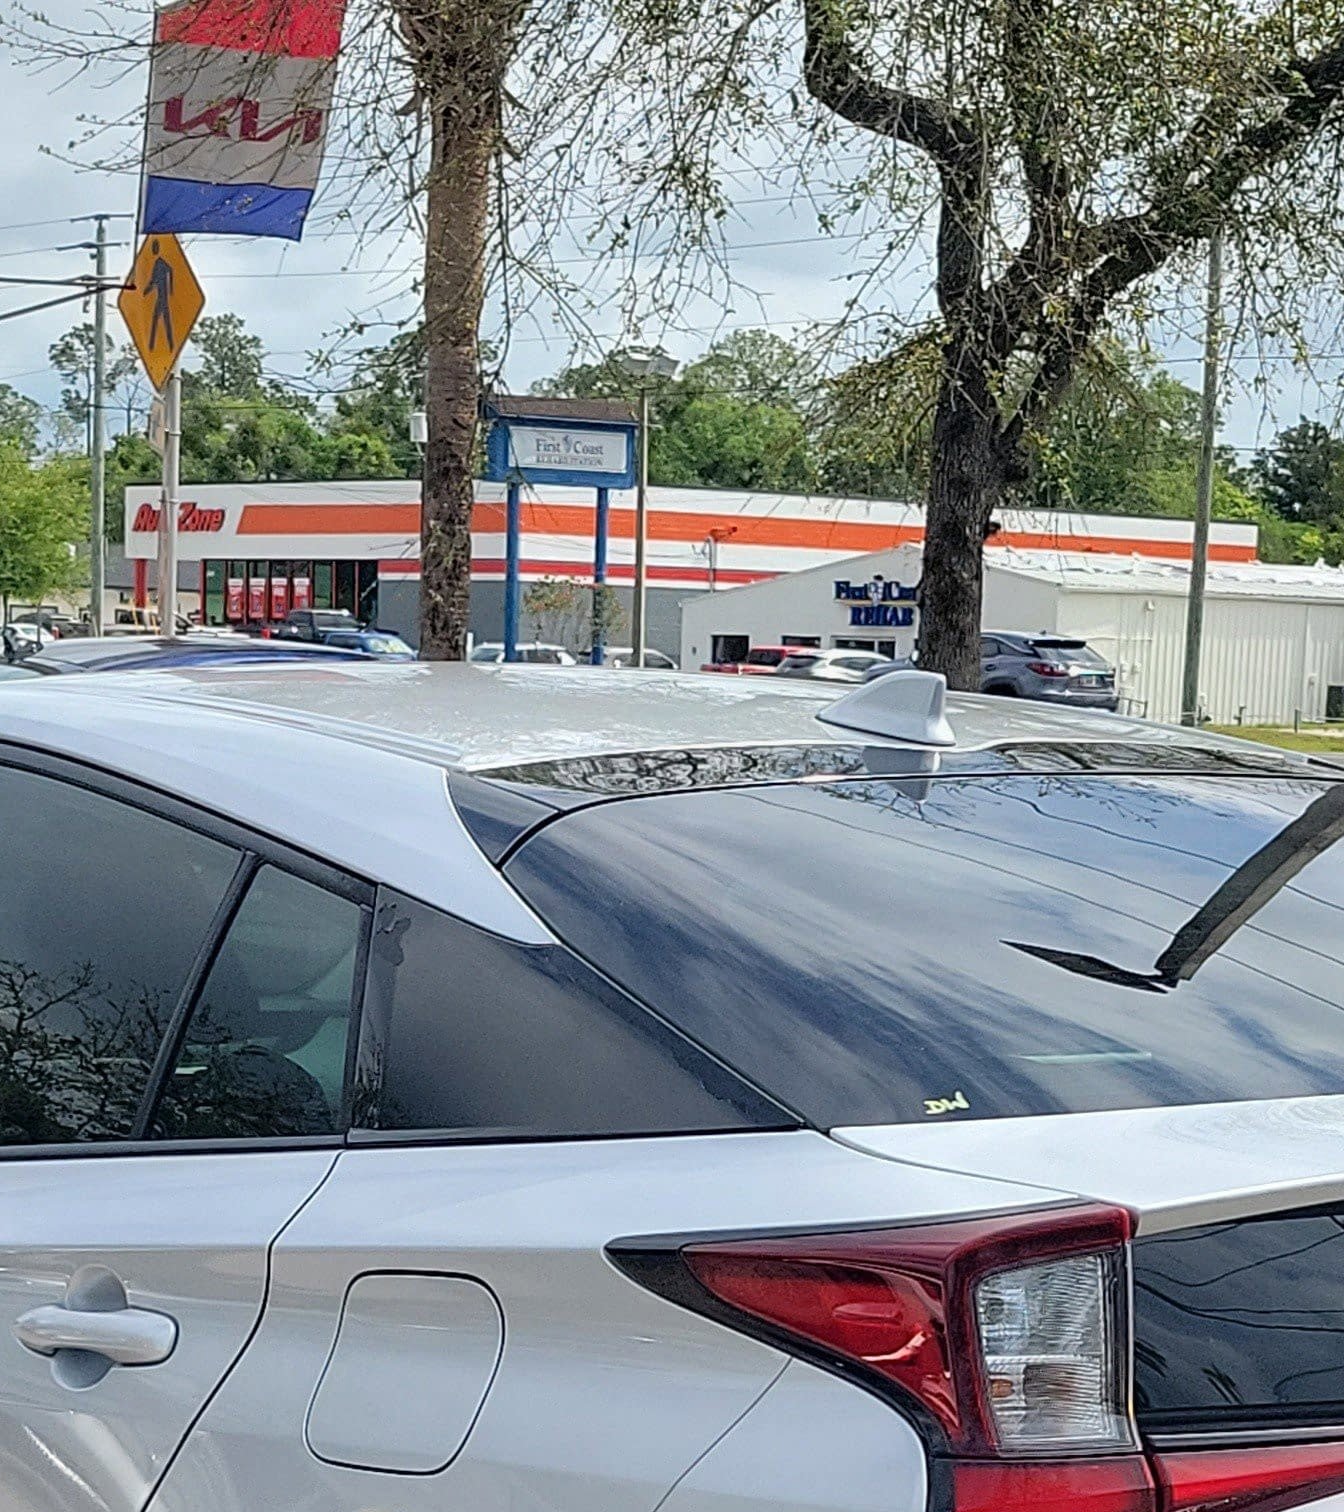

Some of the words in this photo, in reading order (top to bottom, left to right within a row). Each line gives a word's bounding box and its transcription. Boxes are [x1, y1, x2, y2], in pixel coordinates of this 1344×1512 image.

[536, 437, 561, 454] First
[573, 441, 604, 456] Coast
[849, 606, 914, 626] REHAB
